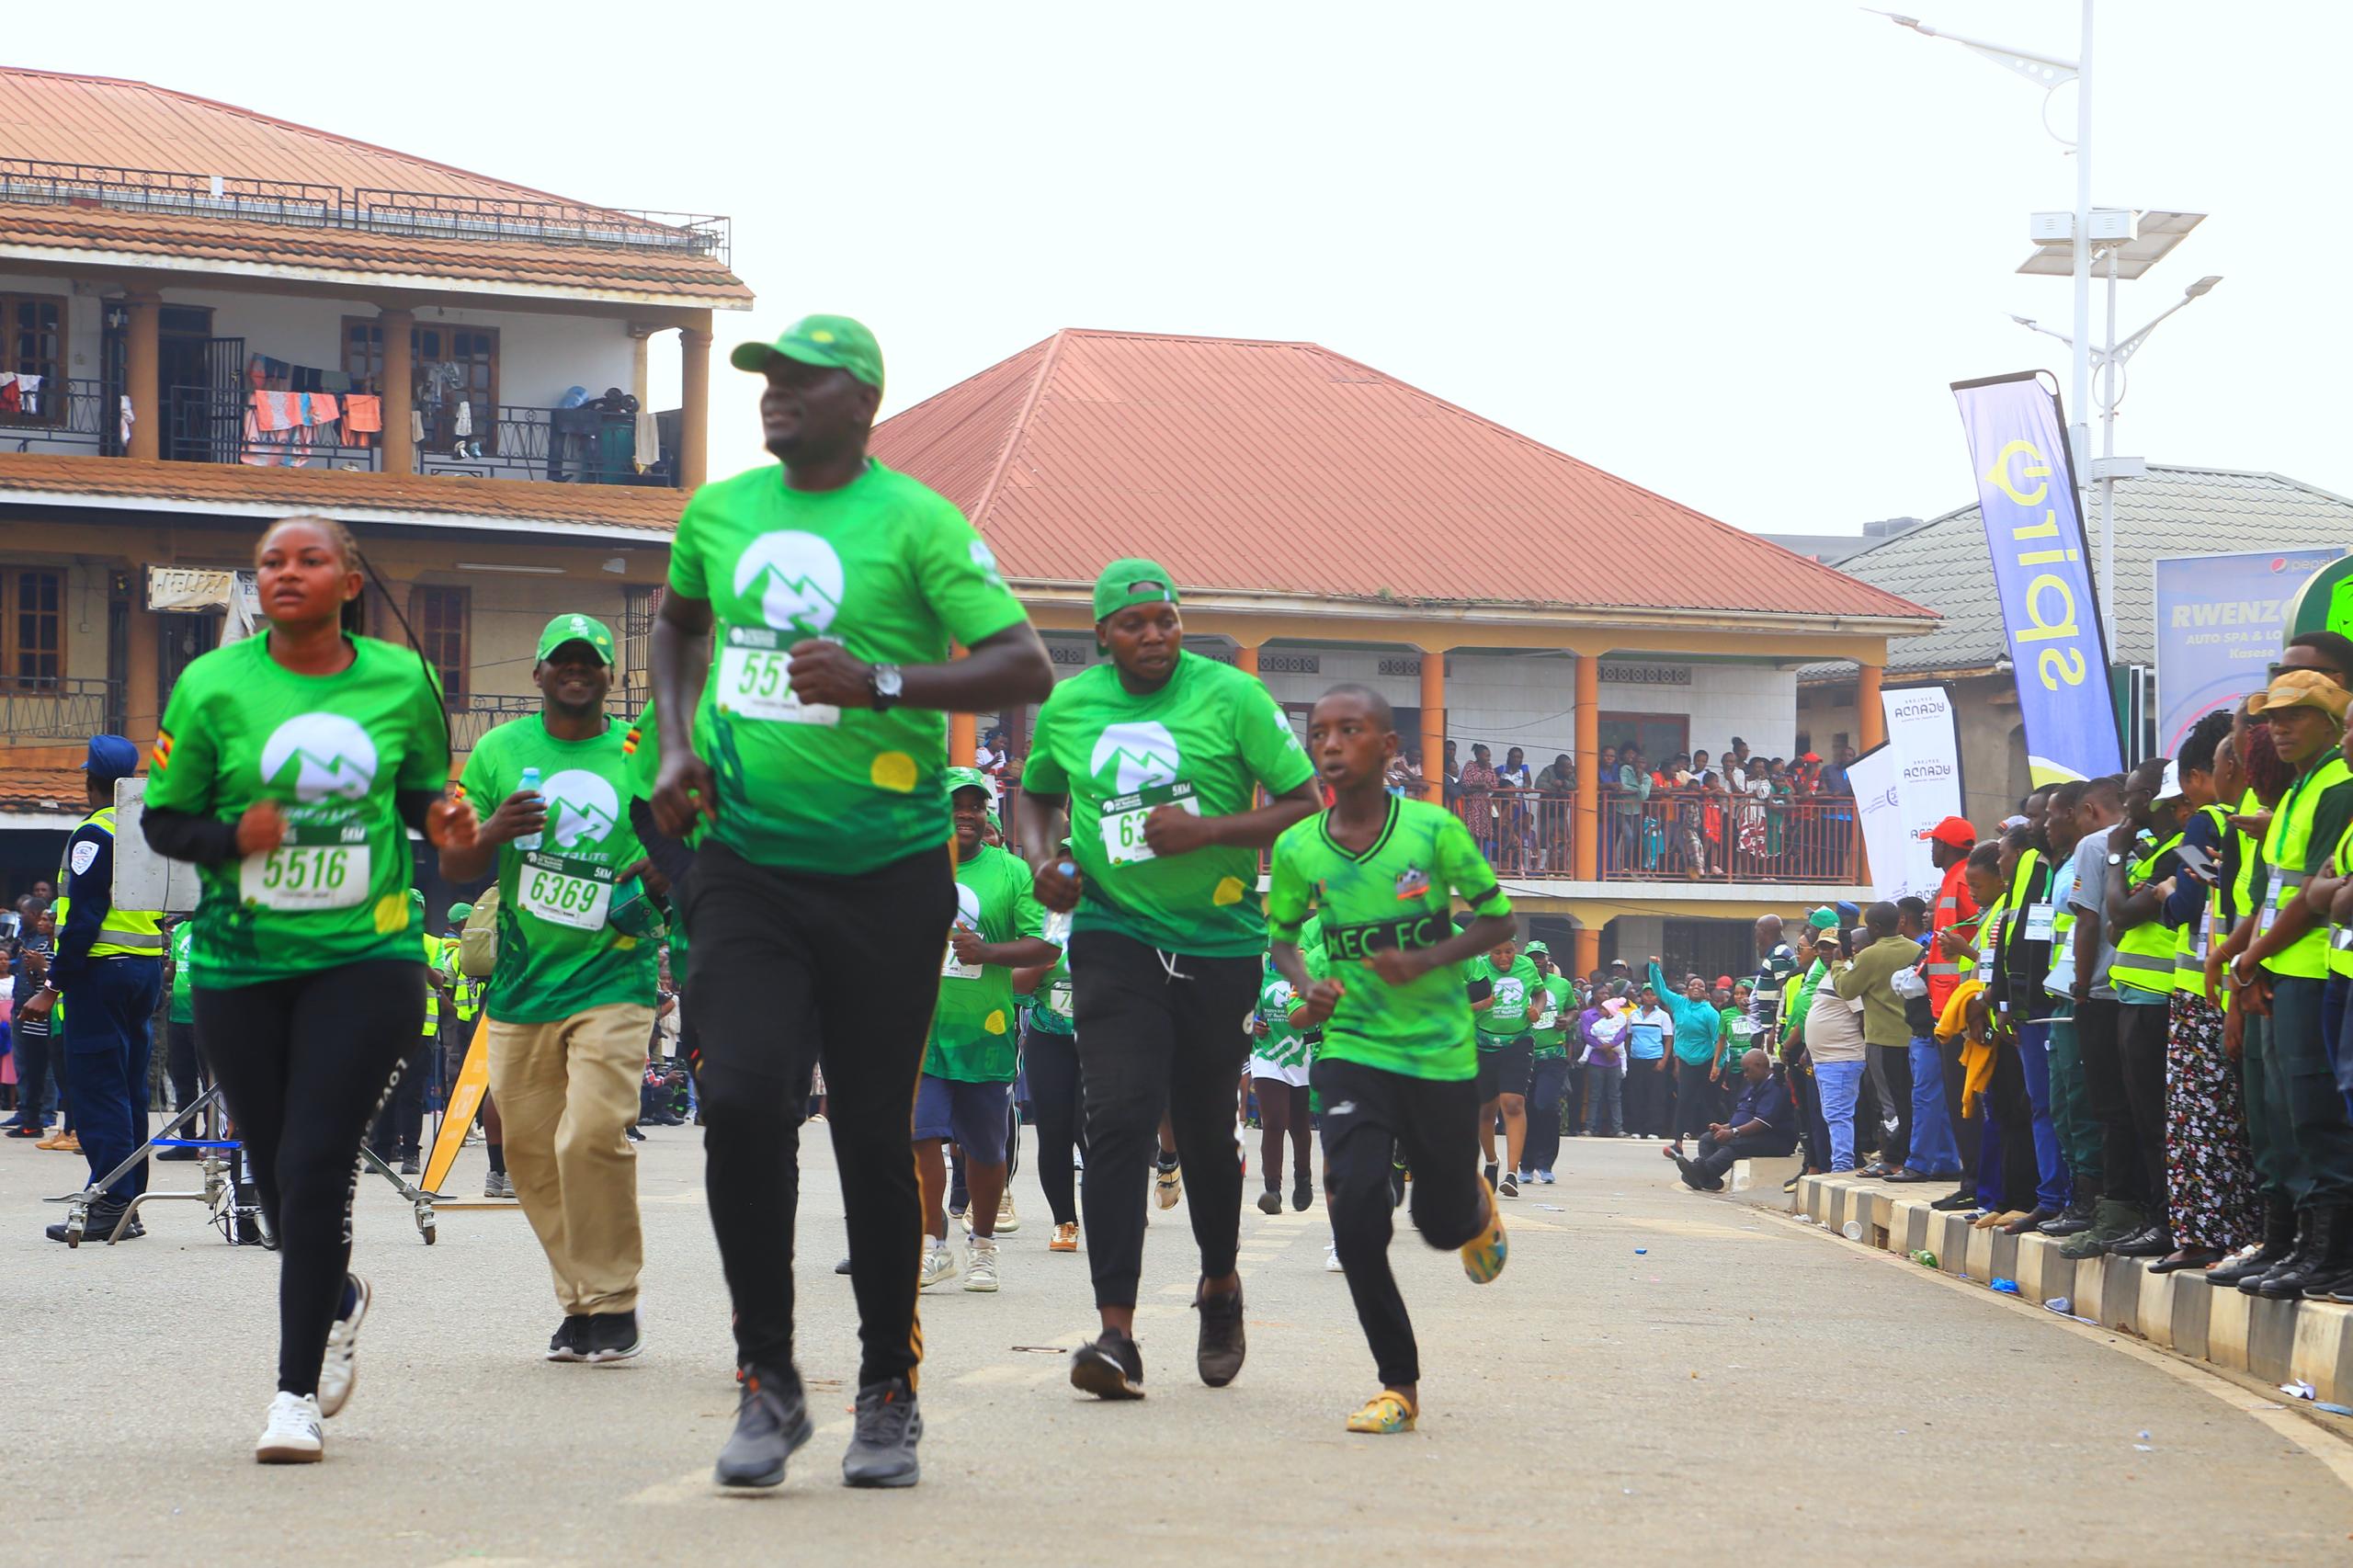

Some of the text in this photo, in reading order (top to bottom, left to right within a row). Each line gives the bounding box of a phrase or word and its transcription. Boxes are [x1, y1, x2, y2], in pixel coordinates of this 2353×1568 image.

[2186, 633, 2221, 645] AUTO
[2228, 632, 2248, 642] SPA
[2252, 631, 2263, 642] &
[2229, 648, 2276, 659] Kasese
[263, 846, 348, 891] 5516
[594, 867, 613, 880] 5KM
[530, 871, 599, 913] 6369
[1395, 917, 1437, 952] FC
